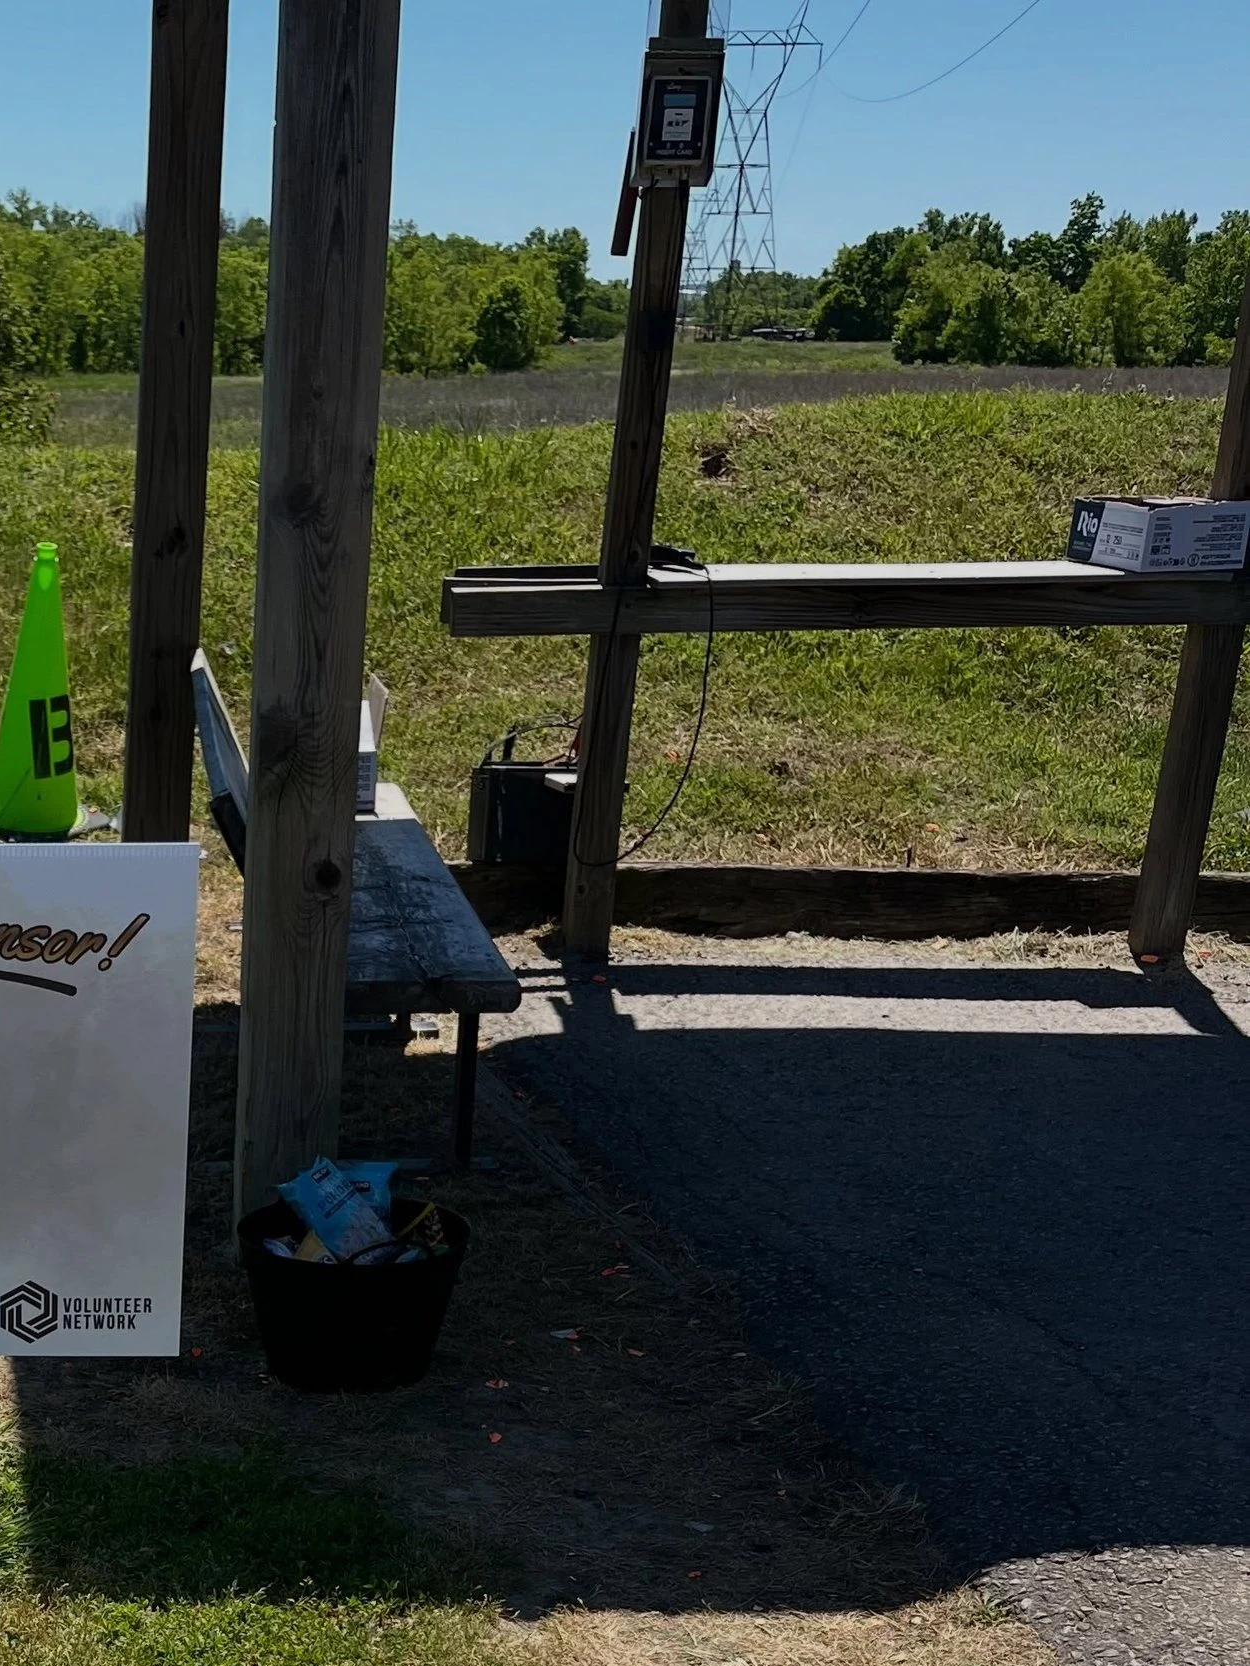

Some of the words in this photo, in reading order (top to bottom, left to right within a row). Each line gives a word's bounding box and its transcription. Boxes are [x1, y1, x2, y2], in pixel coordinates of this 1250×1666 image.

[1077, 510, 1098, 537] Rio
[62, 1297, 153, 1313] VOLUNTEER
[62, 1314, 137, 1330] NETWORK
